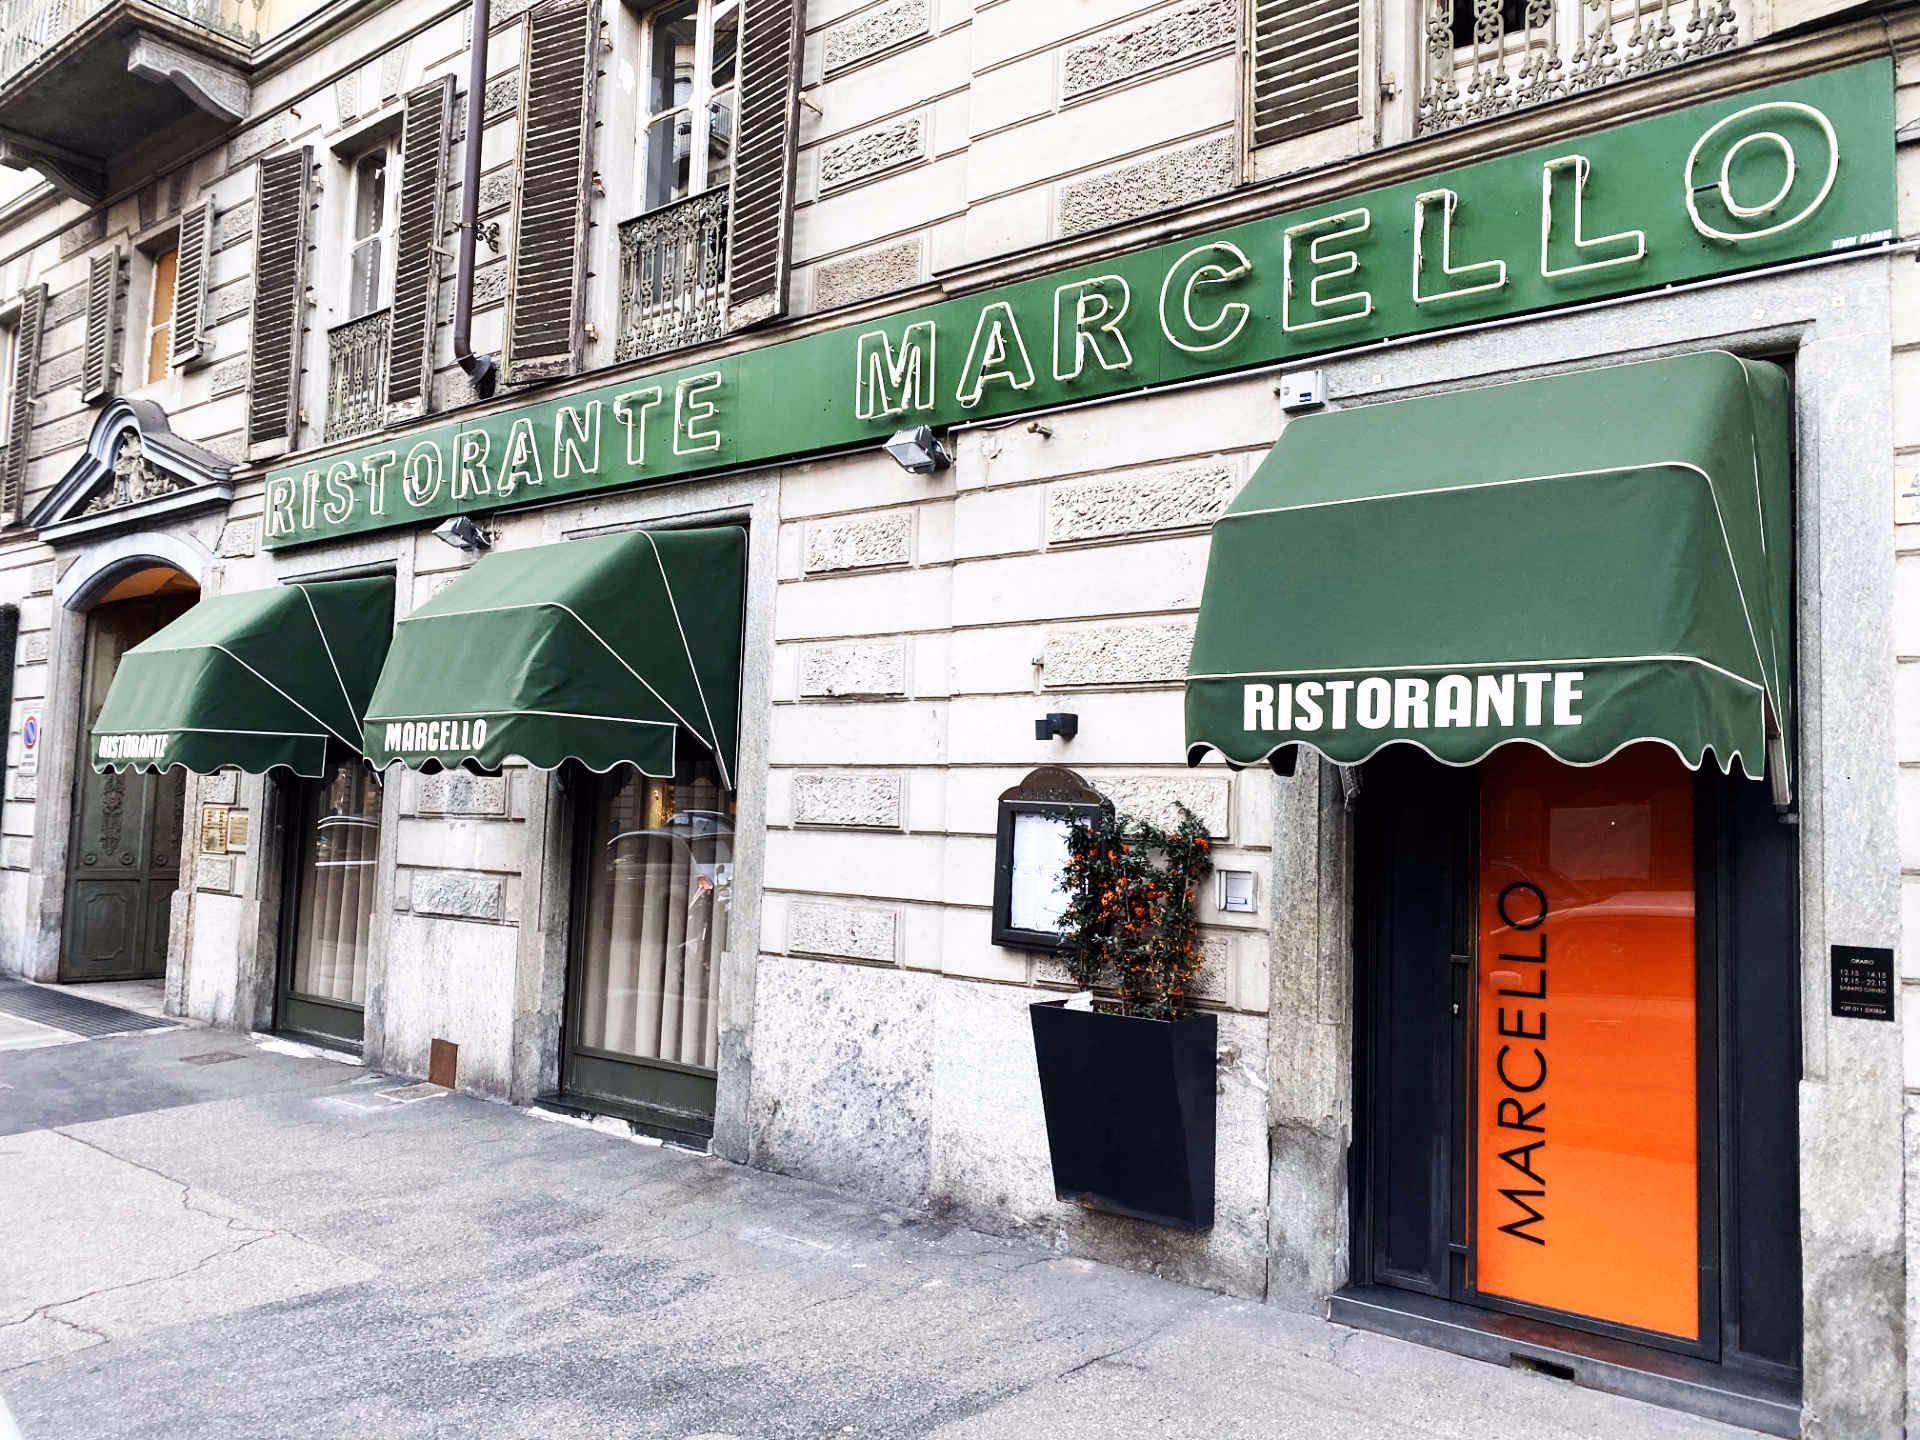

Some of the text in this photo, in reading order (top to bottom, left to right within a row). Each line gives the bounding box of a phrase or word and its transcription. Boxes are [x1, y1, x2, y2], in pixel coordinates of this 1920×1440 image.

[264, 101, 1839, 537] RISTORANTE MARCELLO
[1243, 671, 1584, 732] RISTORANTE
[98, 734, 169, 759] RISTORANTE
[384, 718, 487, 752] MARCELLO
[1497, 881, 1548, 1247] MARCELLO
